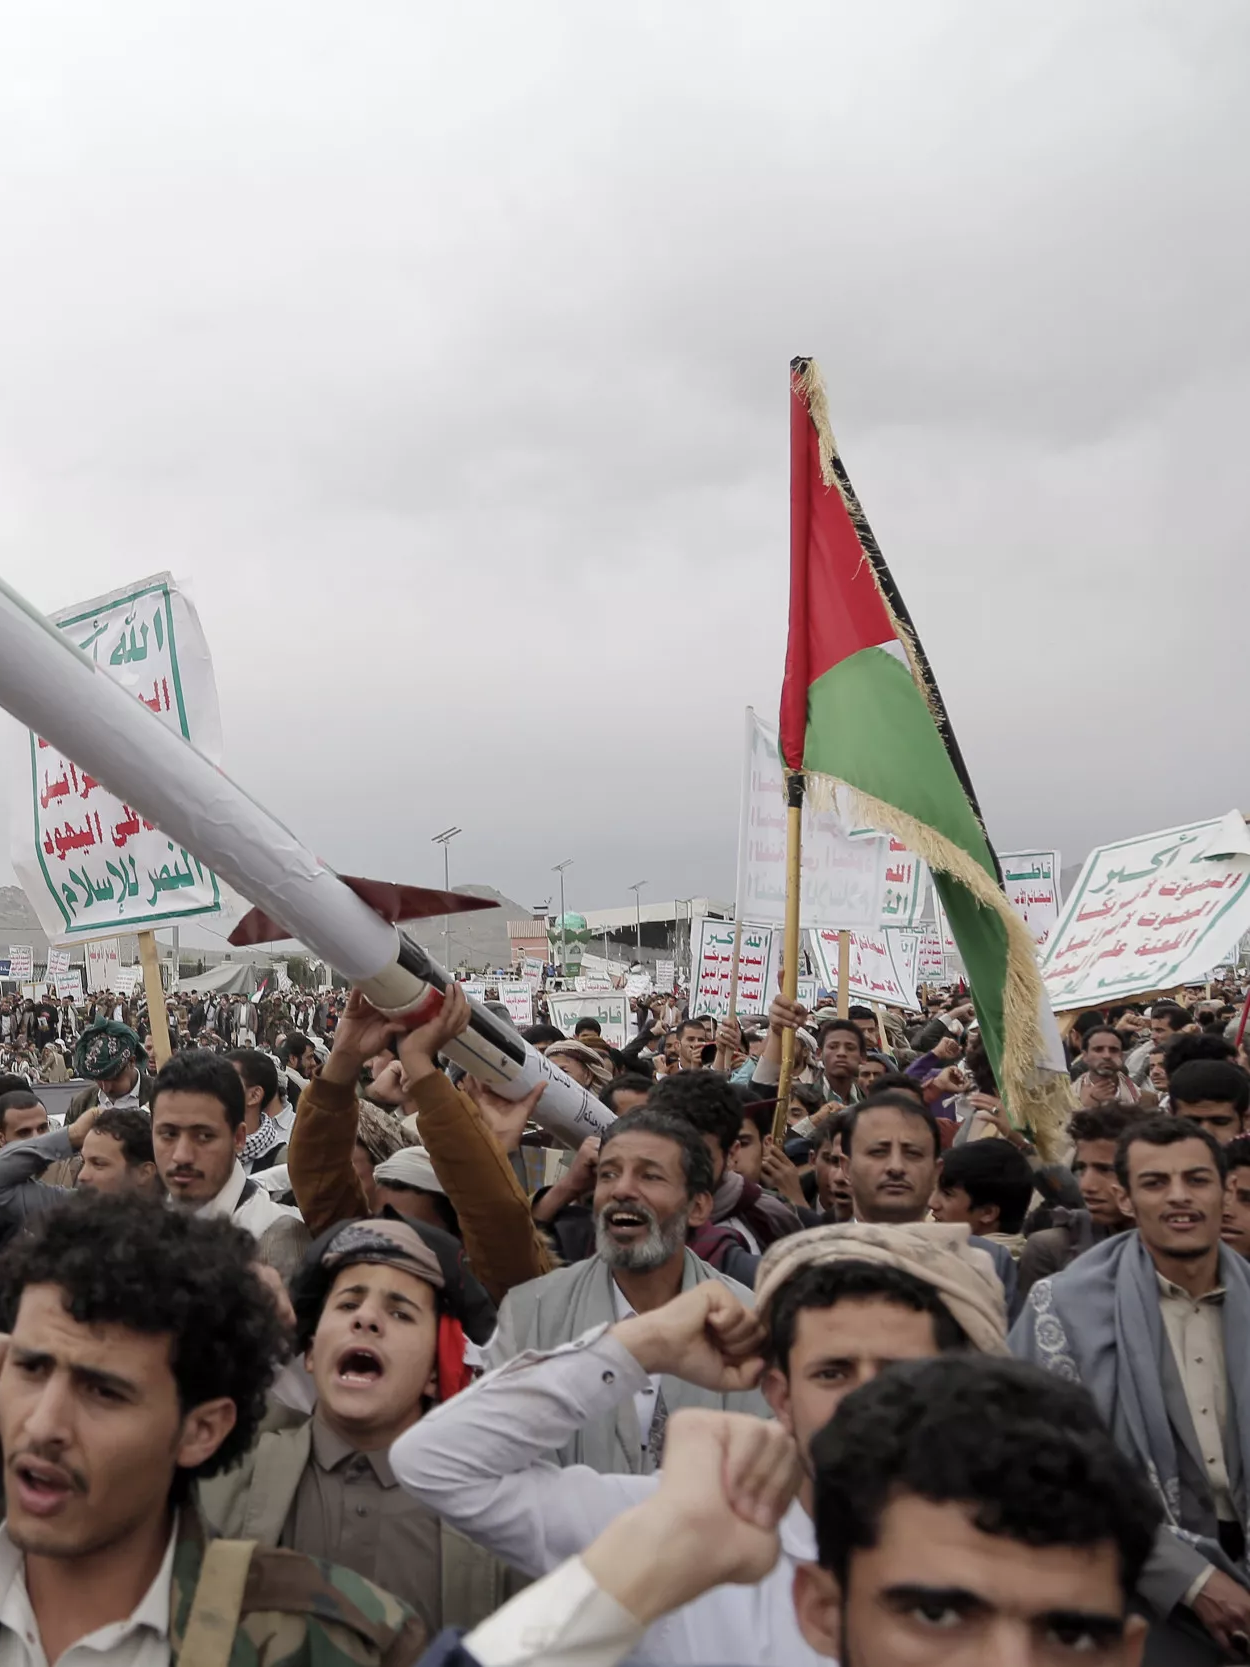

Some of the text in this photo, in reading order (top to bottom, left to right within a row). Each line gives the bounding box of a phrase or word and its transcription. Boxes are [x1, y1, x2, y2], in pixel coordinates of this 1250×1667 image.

[109, 604, 165, 666] الله
[44, 810, 104, 861] اليهود
[704, 931, 768, 948] الله كبر
[740, 987, 762, 1000] اللعنة
